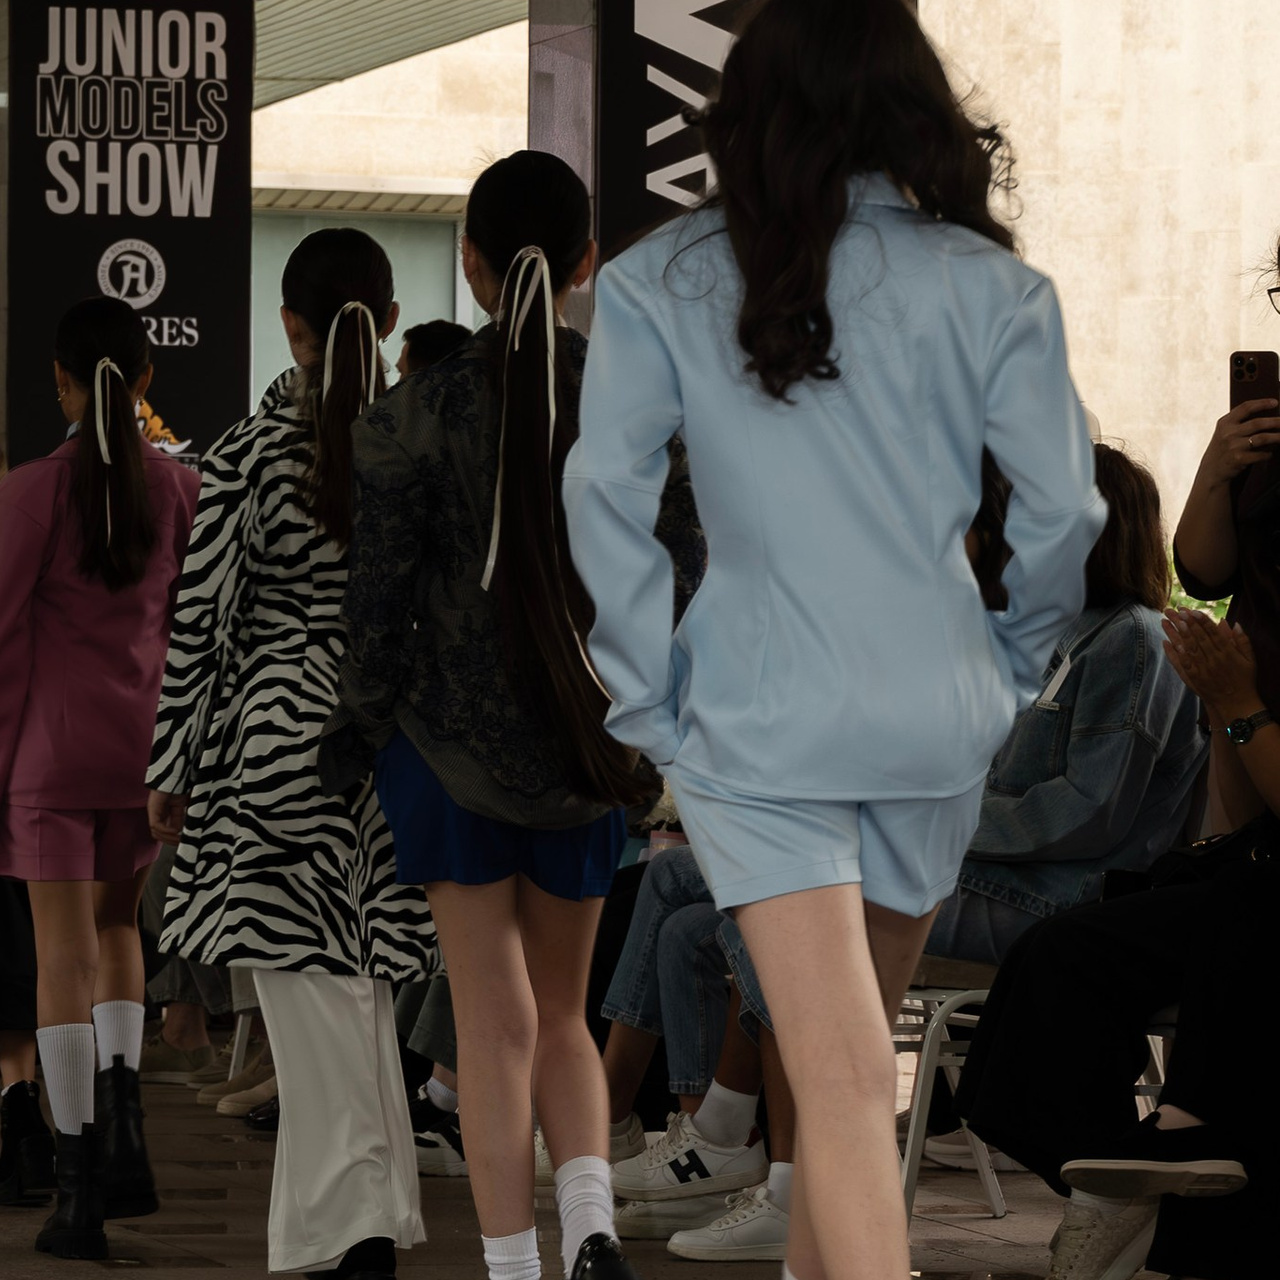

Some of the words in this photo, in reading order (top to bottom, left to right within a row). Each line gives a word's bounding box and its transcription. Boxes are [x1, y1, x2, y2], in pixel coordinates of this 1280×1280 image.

[38, 6, 228, 81] JUNIOR
[36, 74, 228, 143] MODELS
[44, 140, 219, 218] SHOW
[141, 316, 199, 347] RES
